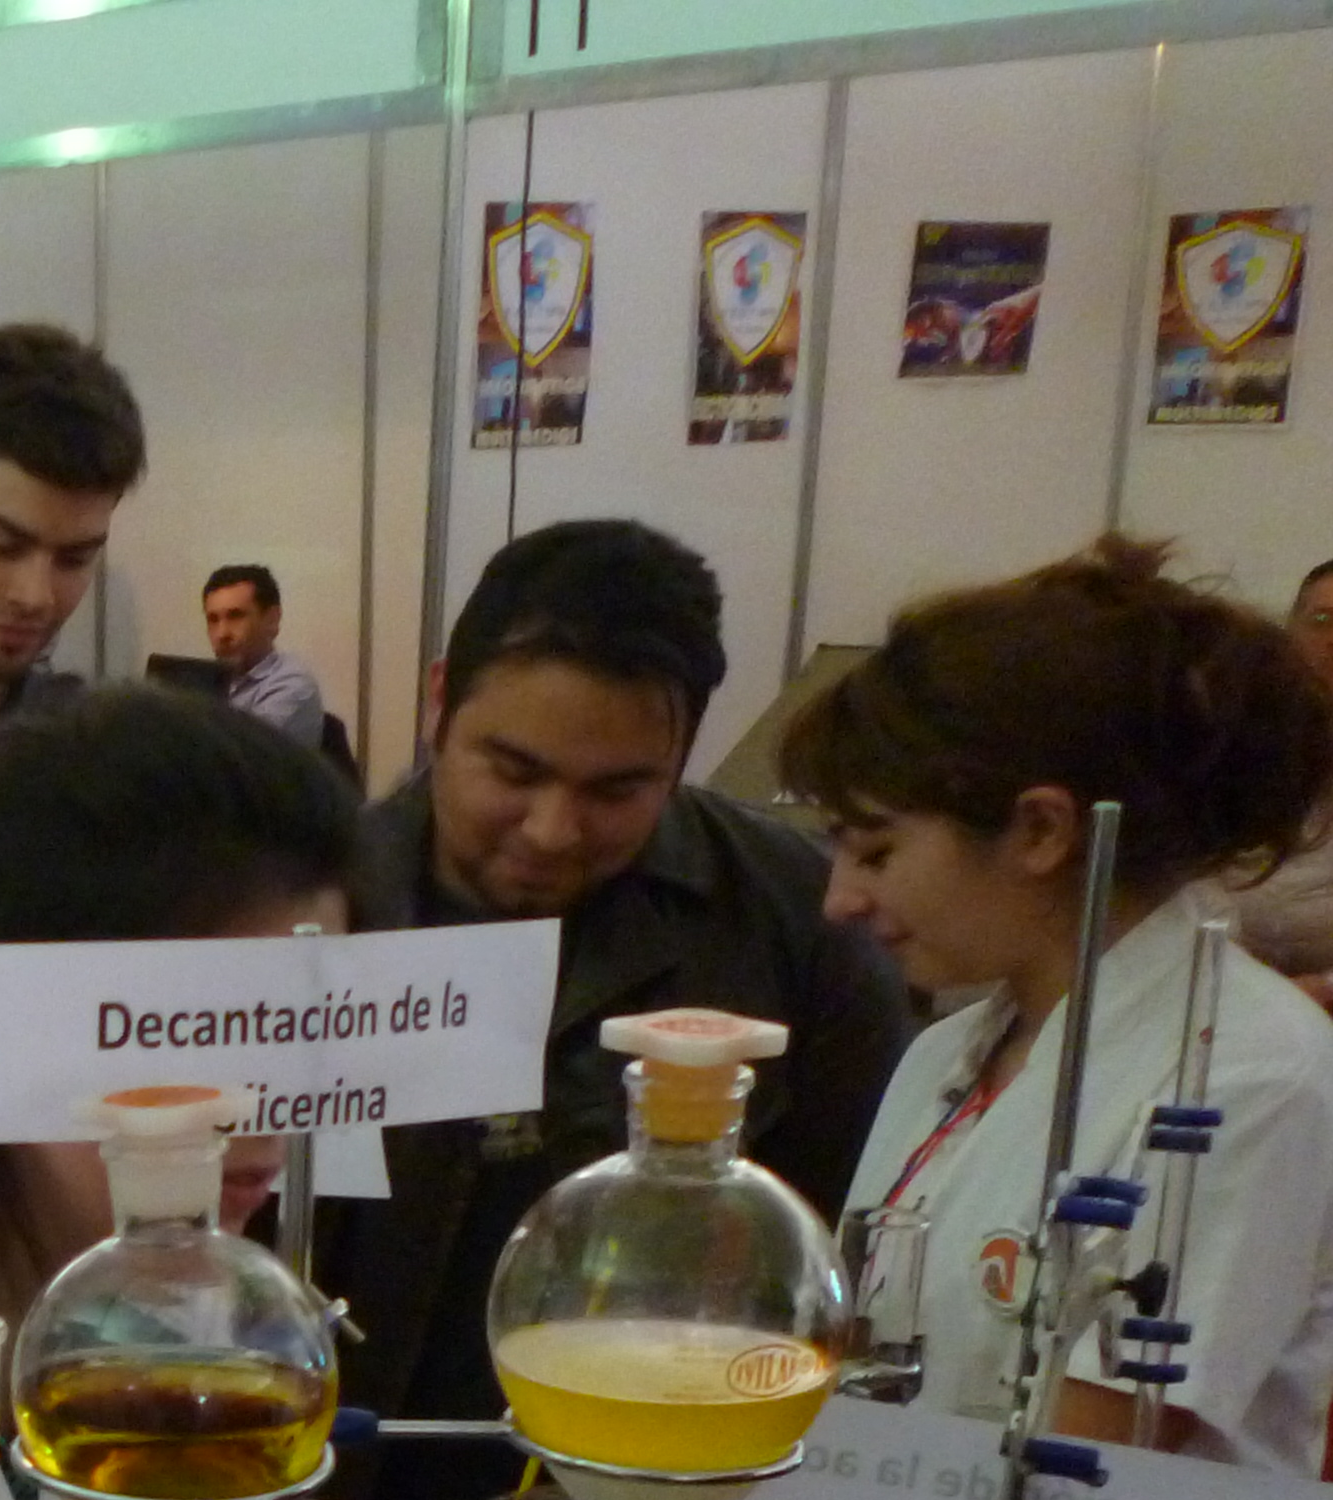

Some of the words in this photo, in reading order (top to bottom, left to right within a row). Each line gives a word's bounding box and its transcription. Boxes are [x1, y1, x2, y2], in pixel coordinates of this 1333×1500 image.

[97, 988, 379, 1051] Decantación
[389, 984, 431, 1034] de
[441, 980, 468, 1029] la
[213, 1078, 387, 1134] icerina
